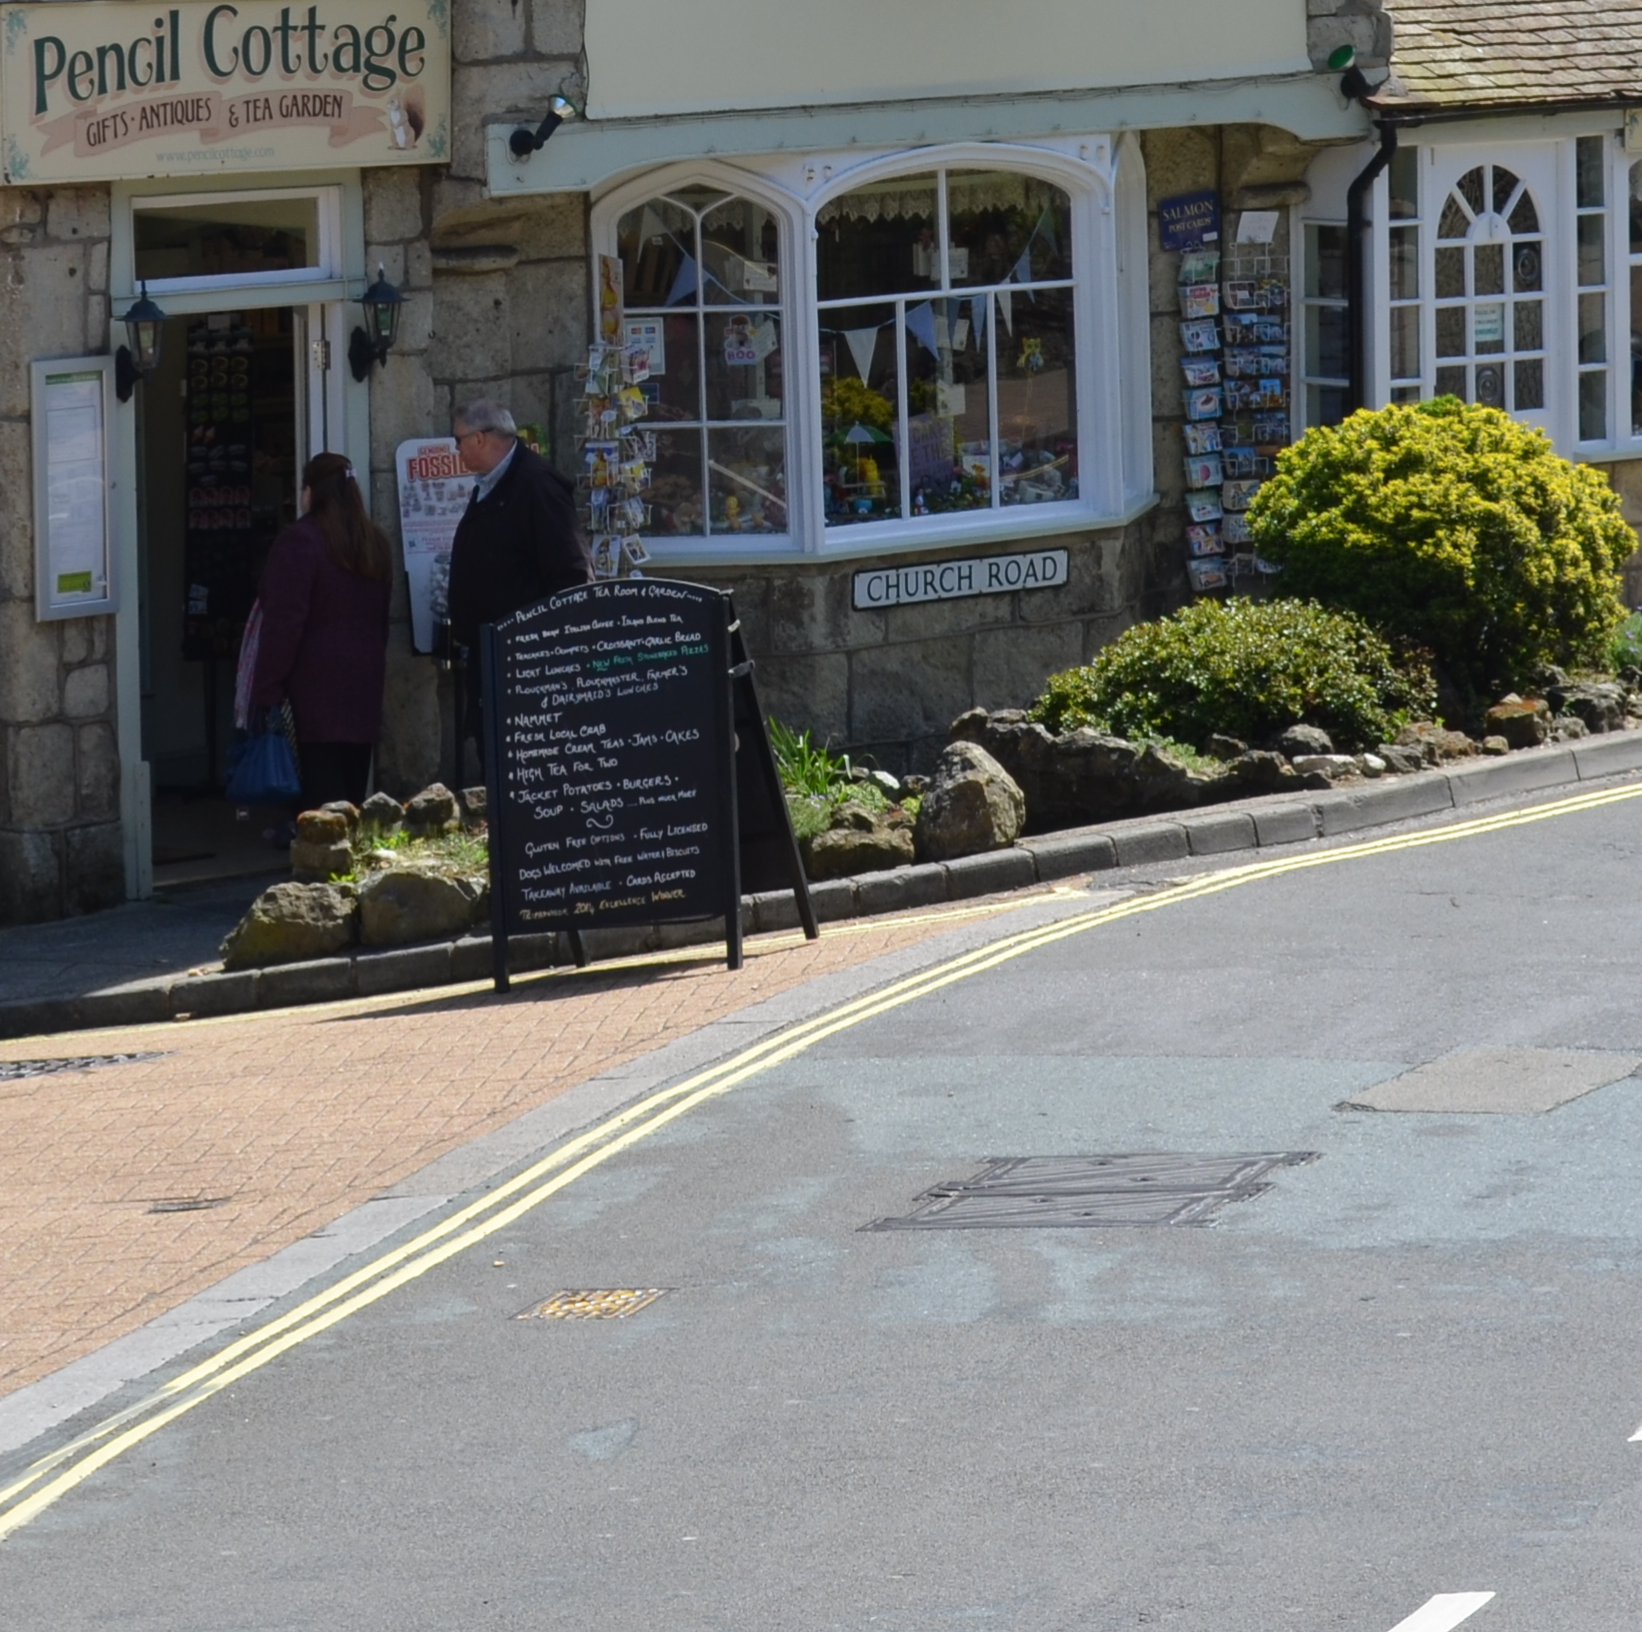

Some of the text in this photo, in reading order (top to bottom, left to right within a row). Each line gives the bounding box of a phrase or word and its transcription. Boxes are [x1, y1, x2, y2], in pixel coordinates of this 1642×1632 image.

[33, 4, 426, 116] Pencil Cottage
[86, 93, 343, 147] GIFTS ANTIQUES & TEA GARDEN
[156, 145, 275, 164] www.pencilcottage.com
[1162, 200, 1214, 221] SALMON
[727, 350, 755, 361] BOO
[408, 454, 469, 481] FOSSIL
[867, 555, 1057, 602] CHURCH ROAD
[549, 590, 589, 611] COTTAGE
[593, 585, 610, 598] TEA
[614, 584, 638, 597] ROOM
[675, 631, 701, 643] BREAD
[514, 723, 606, 743] FRESH LOCAL CRAB
[564, 743, 597, 755] CREAM
[600, 738, 625, 750] TEAS
[631, 734, 658, 748] JAMS
[664, 728, 700, 745] CAKES
[516, 756, 618, 786] HIGH TEA FOR TWO
[517, 775, 672, 804] JACKET POTATOES BURGERS
[533, 797, 624, 820] SOUP SALADS
